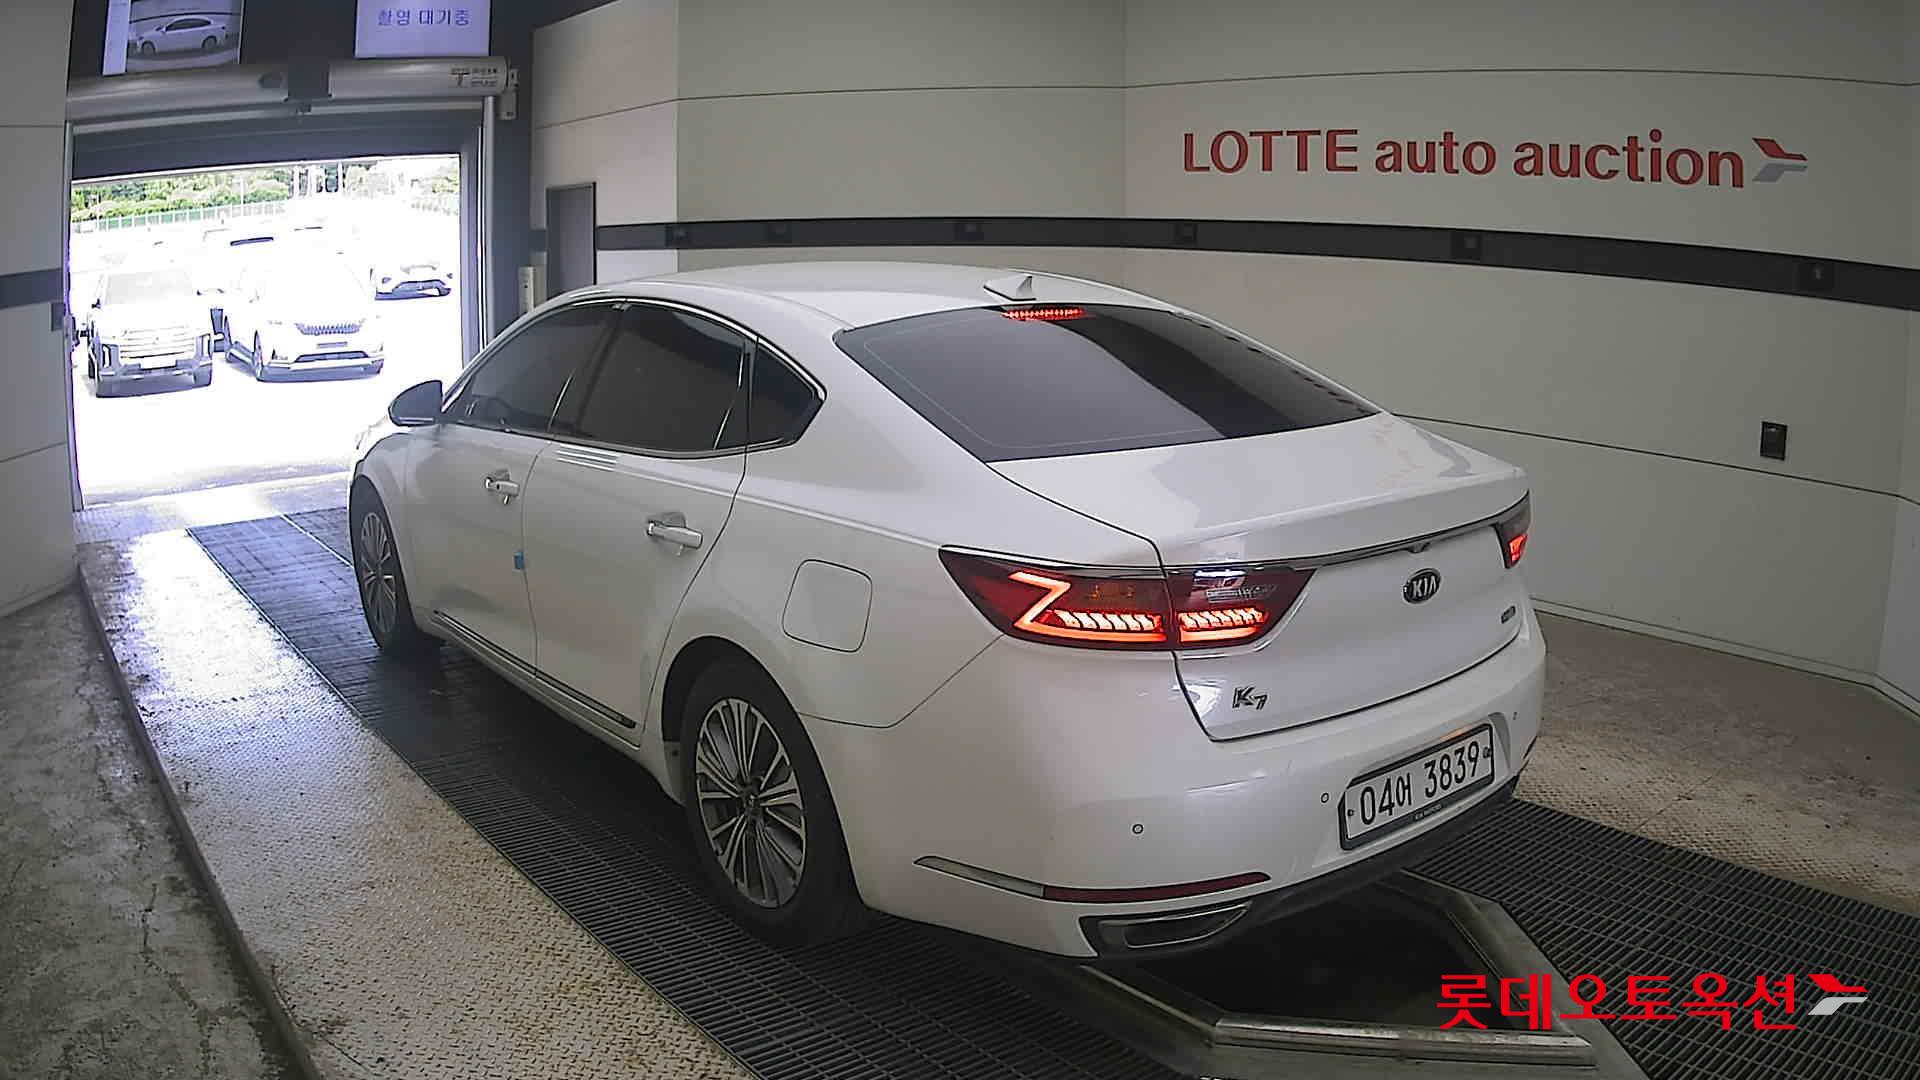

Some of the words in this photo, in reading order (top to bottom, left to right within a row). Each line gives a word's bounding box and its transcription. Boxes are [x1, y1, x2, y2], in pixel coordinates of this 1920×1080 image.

[419, 9, 470, 26] 대기중
[1183, 129, 1359, 174] LOTTE
[1375, 131, 1497, 176] auto
[1513, 129, 1744, 188] auction
[1412, 575, 1437, 598] KIA
[1232, 686, 1268, 710] K7
[1360, 772, 1412, 825] 04어
[1424, 741, 1480, 798] 3839
